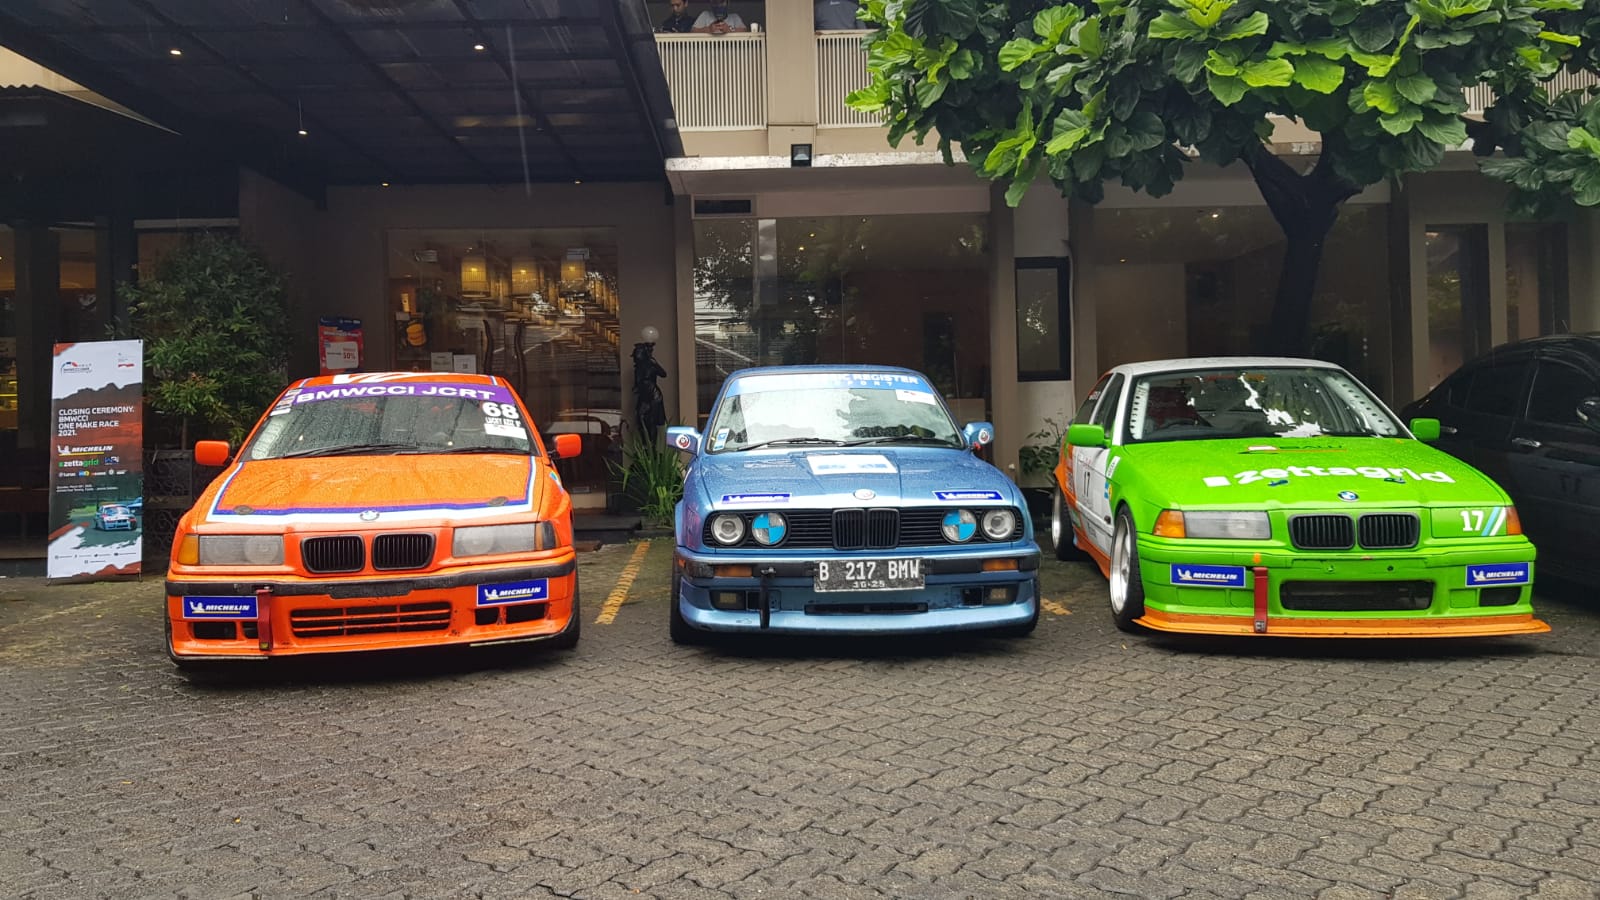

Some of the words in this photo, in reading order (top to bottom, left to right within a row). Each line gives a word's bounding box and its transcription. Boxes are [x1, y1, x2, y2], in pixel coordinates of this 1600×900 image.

[296, 385, 414, 403] BMWCCI
[422, 386, 495, 400] JCRT
[482, 402, 519, 419] 68
[71, 445, 113, 453] MICHELIN
[63, 458, 99, 467] zettagrid
[1234, 465, 1456, 485] zettagrid
[1460, 510, 1484, 531] 17
[819, 561, 829, 581] B
[845, 561, 876, 580] 217
[888, 559, 920, 578] BMW
[1193, 572, 1238, 580] MICHELIN
[499, 587, 541, 596] MICHELIN
